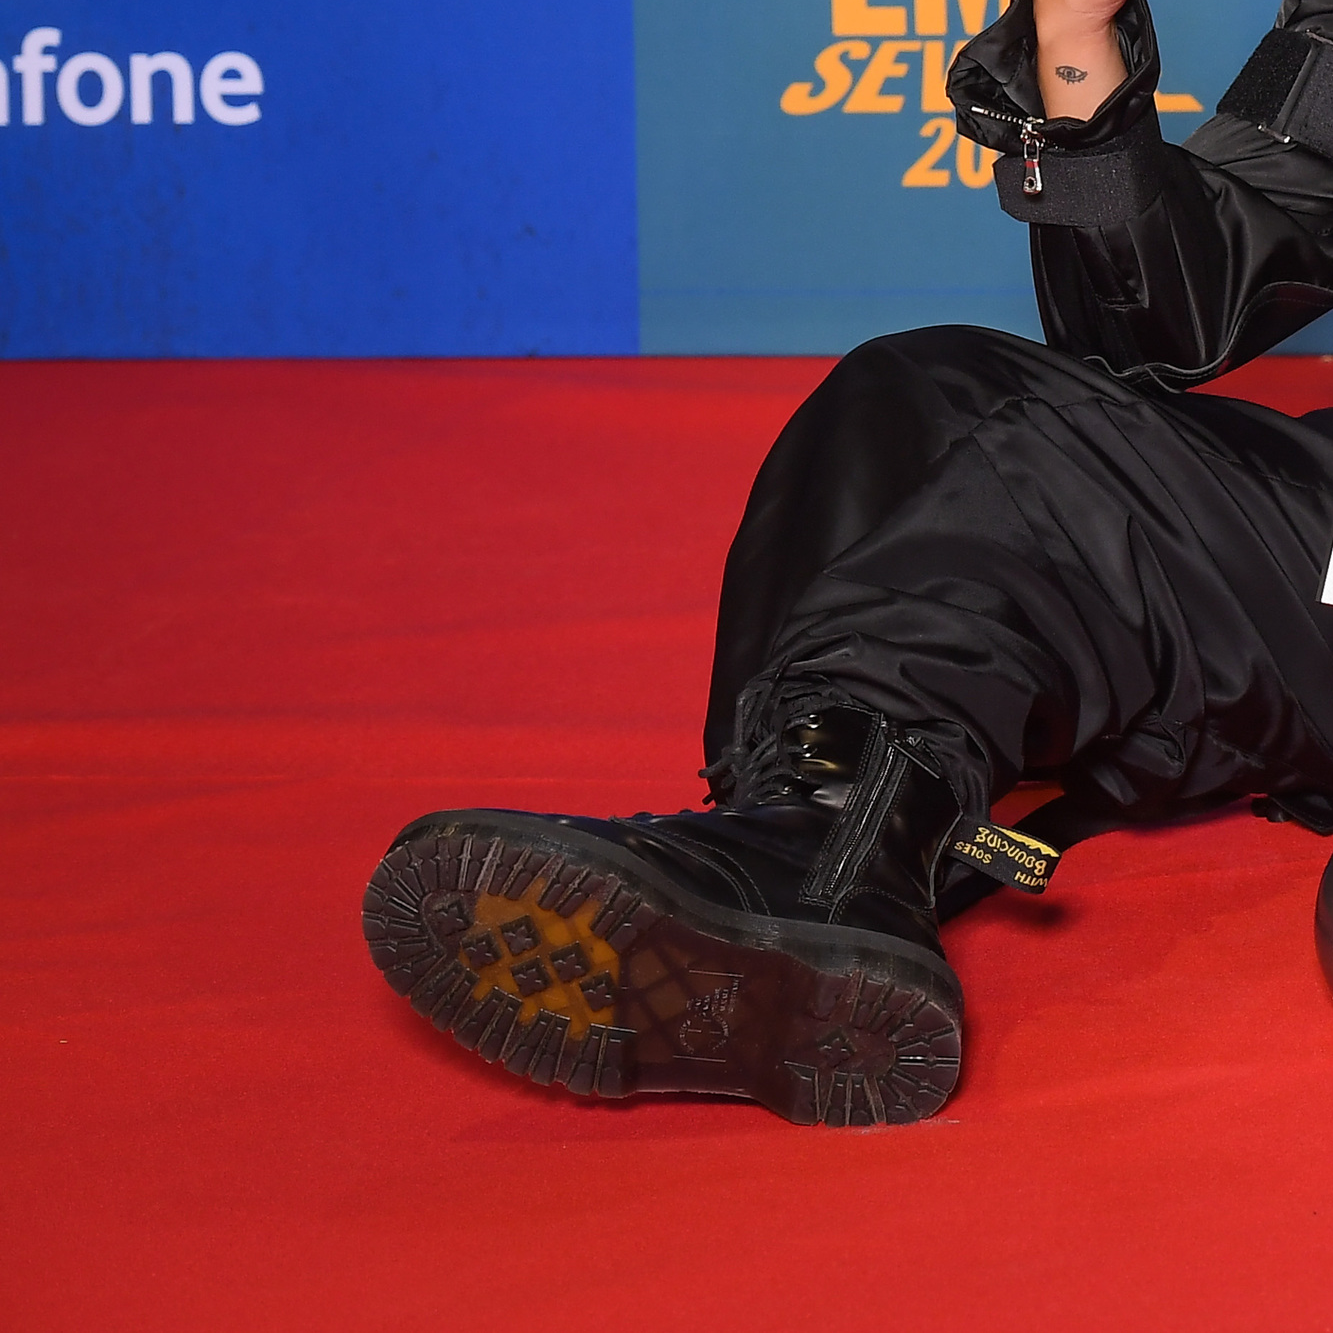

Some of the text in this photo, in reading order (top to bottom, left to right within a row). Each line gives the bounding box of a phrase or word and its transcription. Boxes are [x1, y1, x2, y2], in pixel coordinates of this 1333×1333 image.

[0, 27, 264, 127] fone
[902, 117, 999, 189] 20
[953, 826, 1048, 888] WITH Bouncing SOLES
